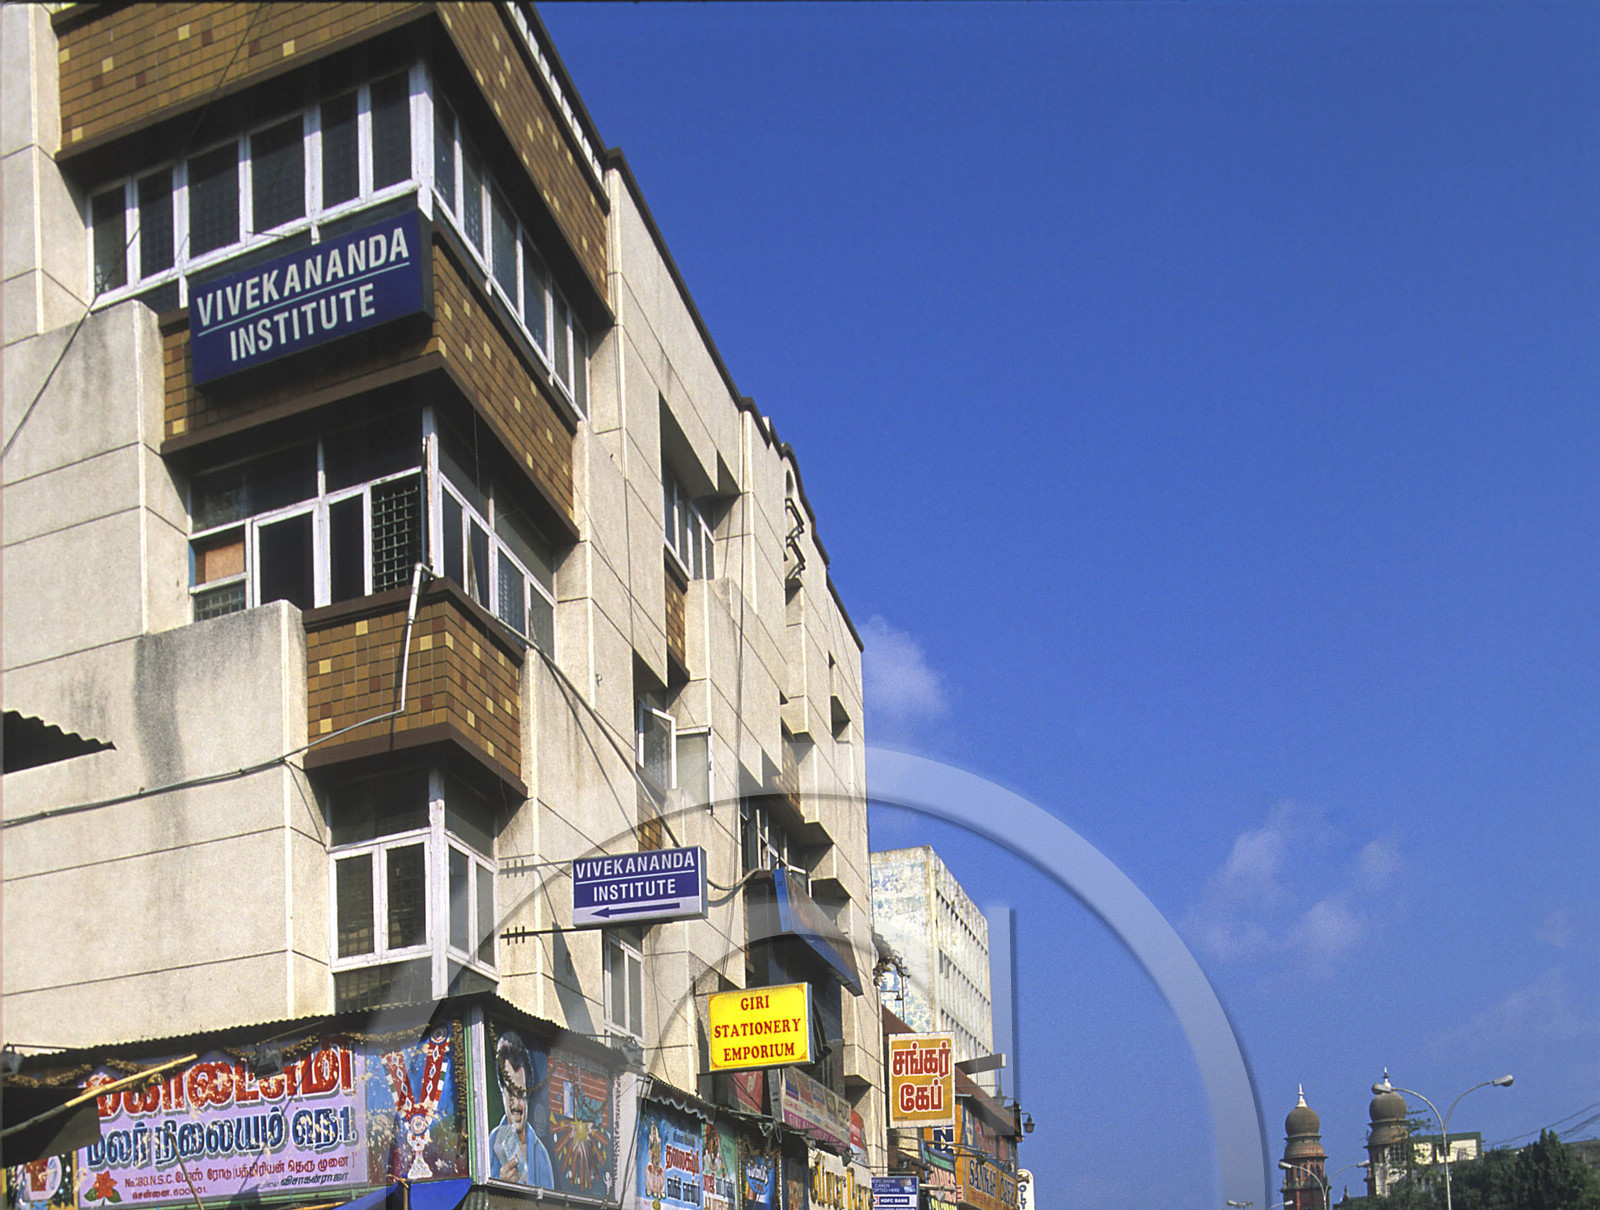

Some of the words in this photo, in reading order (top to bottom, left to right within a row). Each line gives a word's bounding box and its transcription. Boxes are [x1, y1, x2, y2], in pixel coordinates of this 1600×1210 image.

[196, 227, 411, 329] VIVEKANANDA
[229, 282, 377, 363] INSTITUTE
[575, 851, 696, 880] VIVEKANANDA
[593, 878, 677, 902] INSTITUTE
[740, 995, 770, 1011] GIRI
[714, 1017, 801, 1039] STATIONERY
[723, 1042, 796, 1062] EMPORIUM
[892, 1041, 951, 1078] சங்கர்
[900, 1078, 943, 1112] கேப்
